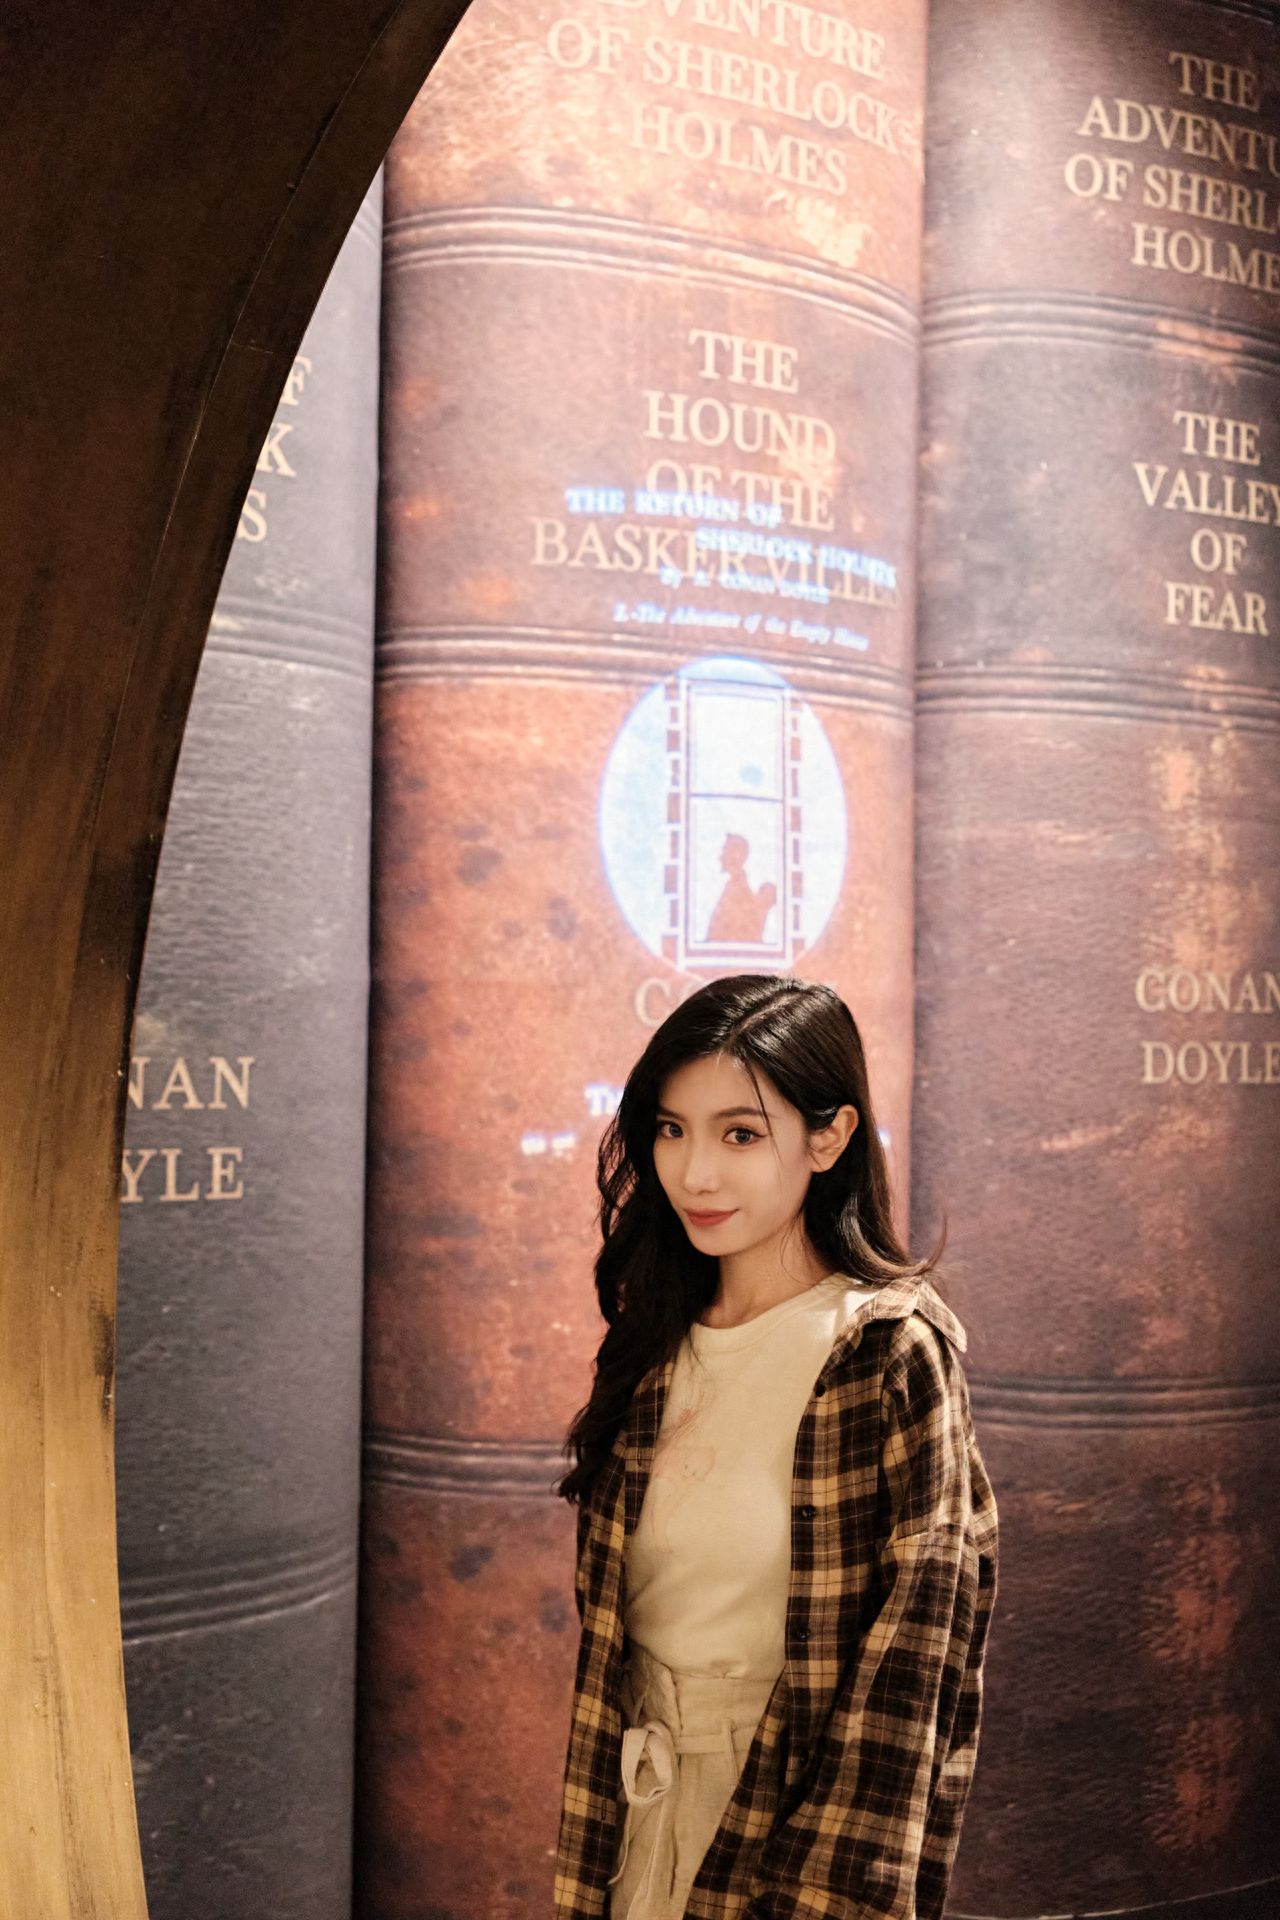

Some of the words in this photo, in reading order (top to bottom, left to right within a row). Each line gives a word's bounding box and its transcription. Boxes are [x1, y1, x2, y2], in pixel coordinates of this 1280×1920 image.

[547, 18, 631, 76] OF
[642, 36, 898, 154] SHERLOCK
[1168, 51, 1260, 112] THE
[631, 102, 849, 196] HOLMES
[1064, 153, 1134, 201] OF
[689, 328, 799, 394] THE
[643, 389, 837, 465] HOUND
[1172, 410, 1261, 466] THE
[565, 487, 625, 514] THE
[646, 459, 722, 510] OF
[731, 467, 836, 532] THE
[1190, 528, 1247, 576] OF
[1164, 581, 1269, 637] FEAR
